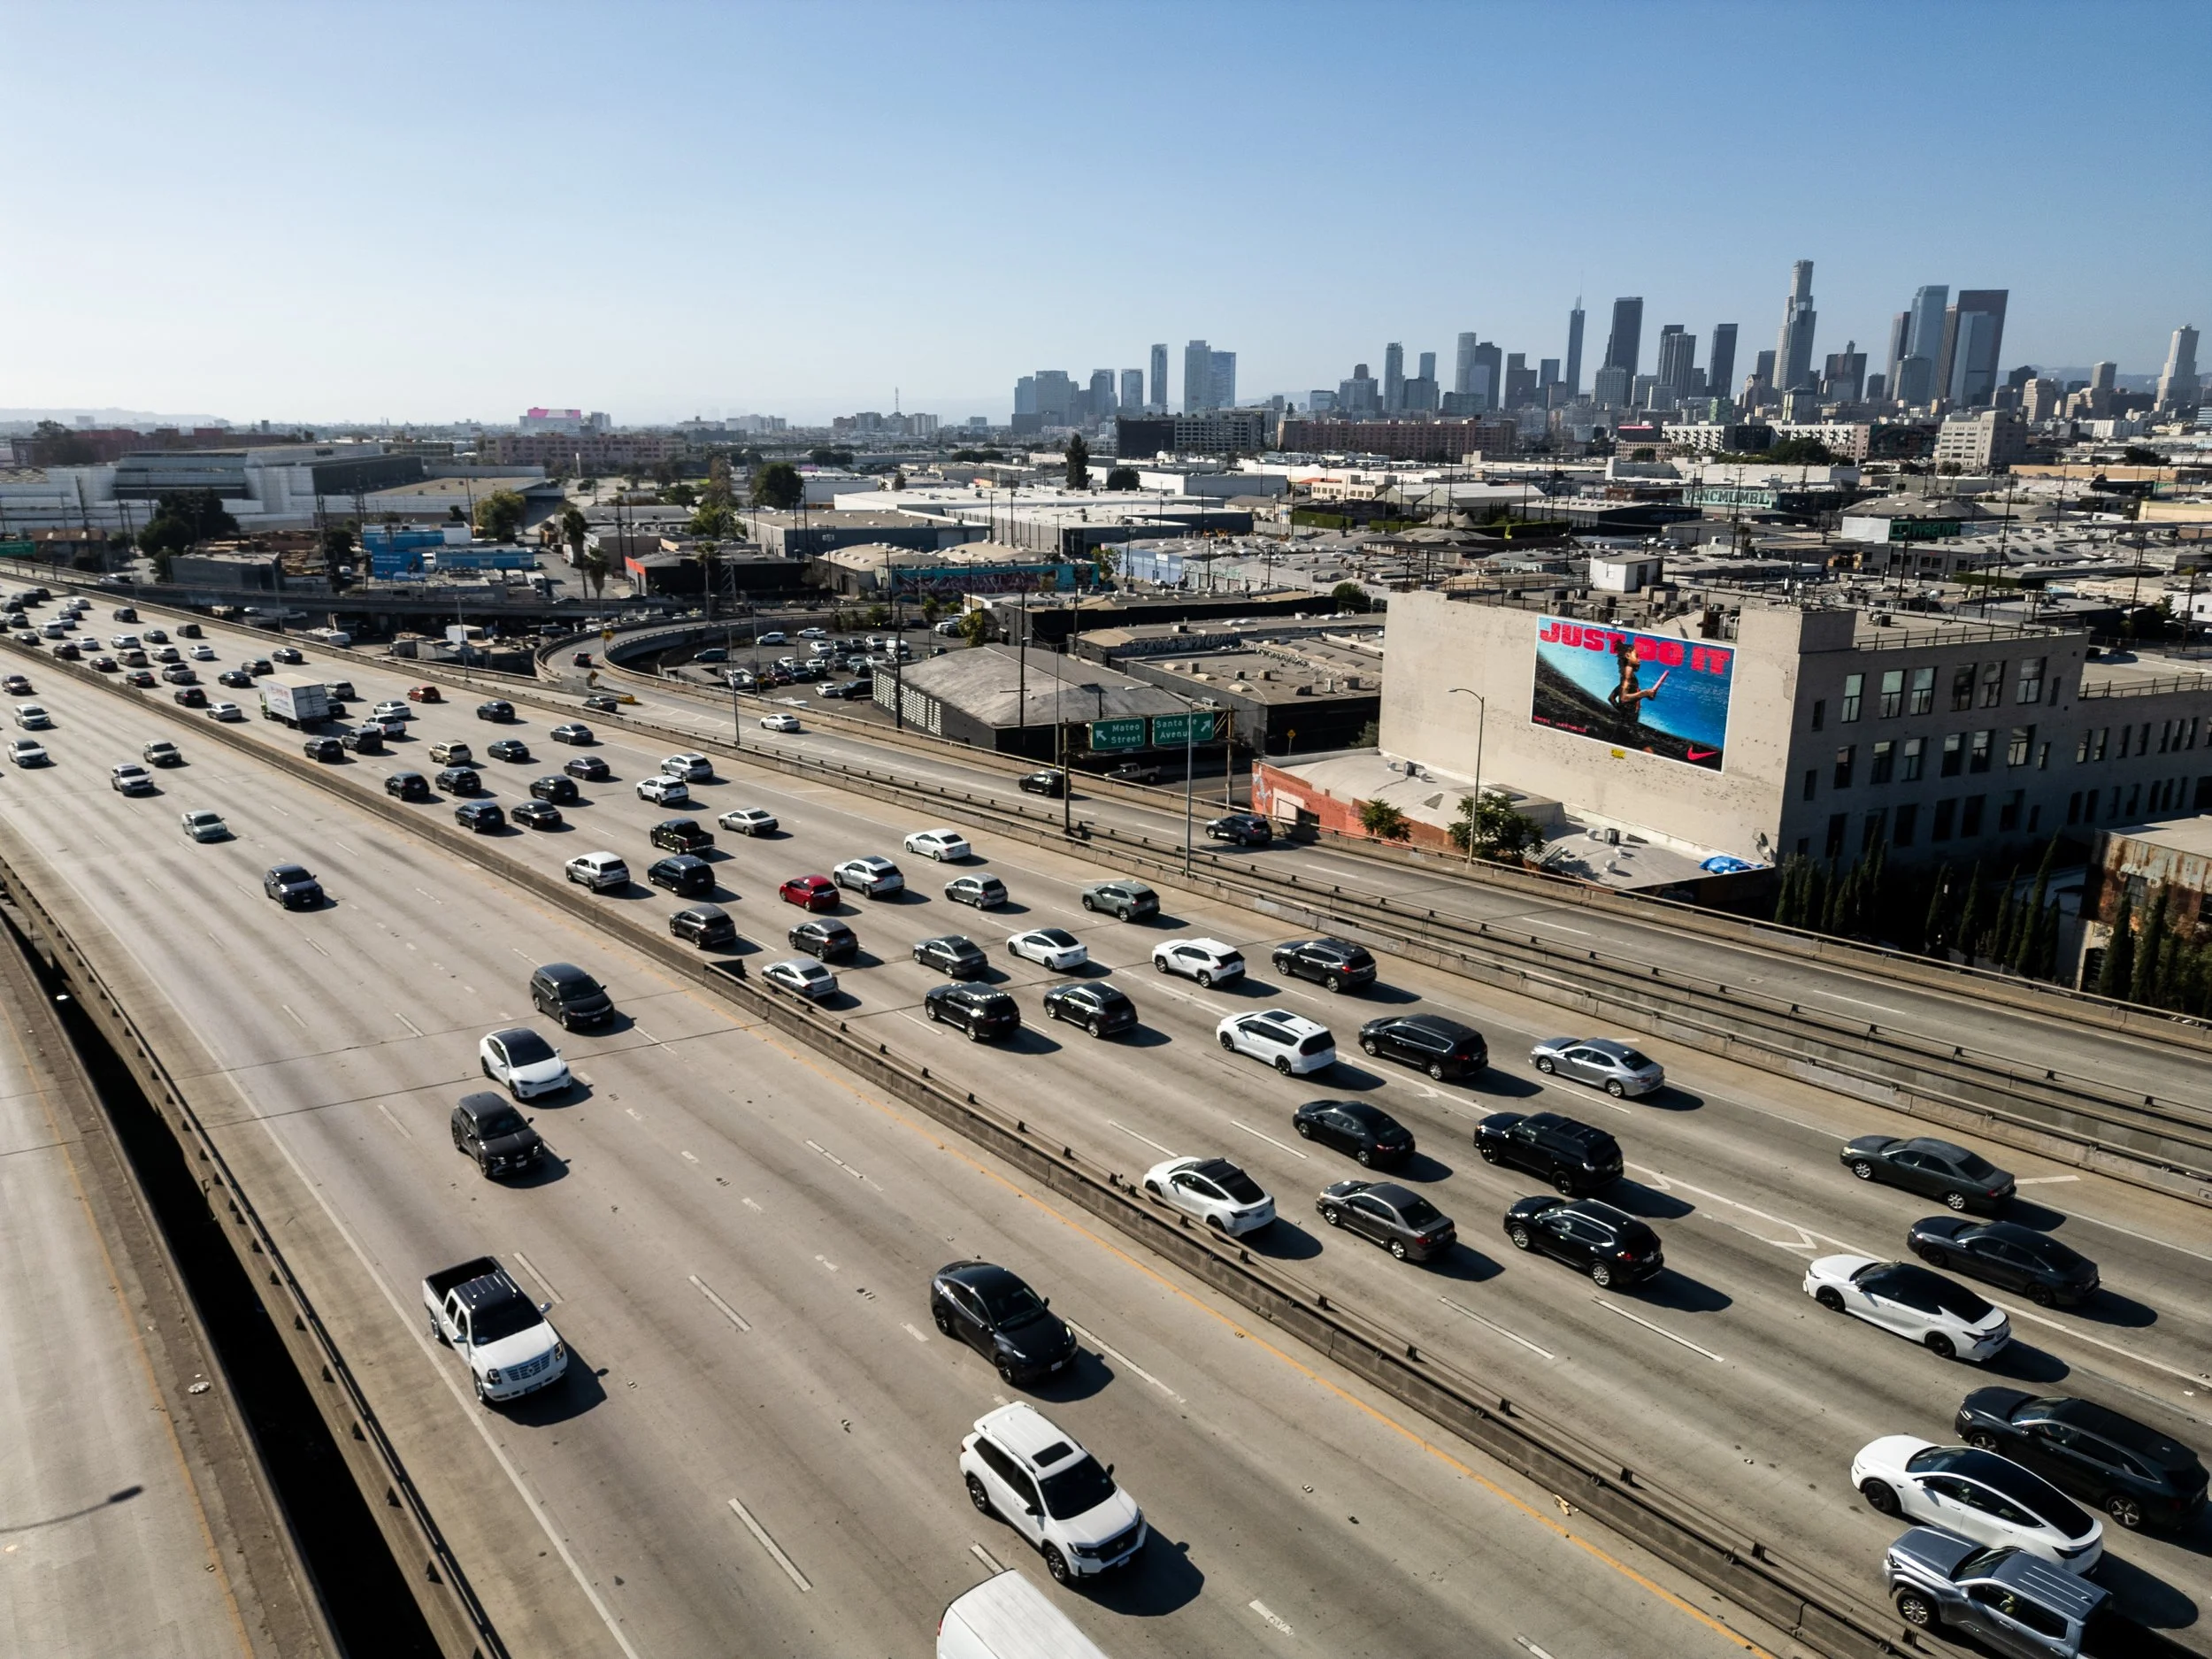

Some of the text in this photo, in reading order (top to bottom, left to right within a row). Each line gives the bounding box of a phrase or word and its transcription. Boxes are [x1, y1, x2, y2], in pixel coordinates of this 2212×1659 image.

[1540, 622, 1731, 675] JUST DO IT
[1156, 719, 1183, 728] Santa
[1111, 734, 1141, 743] Street
